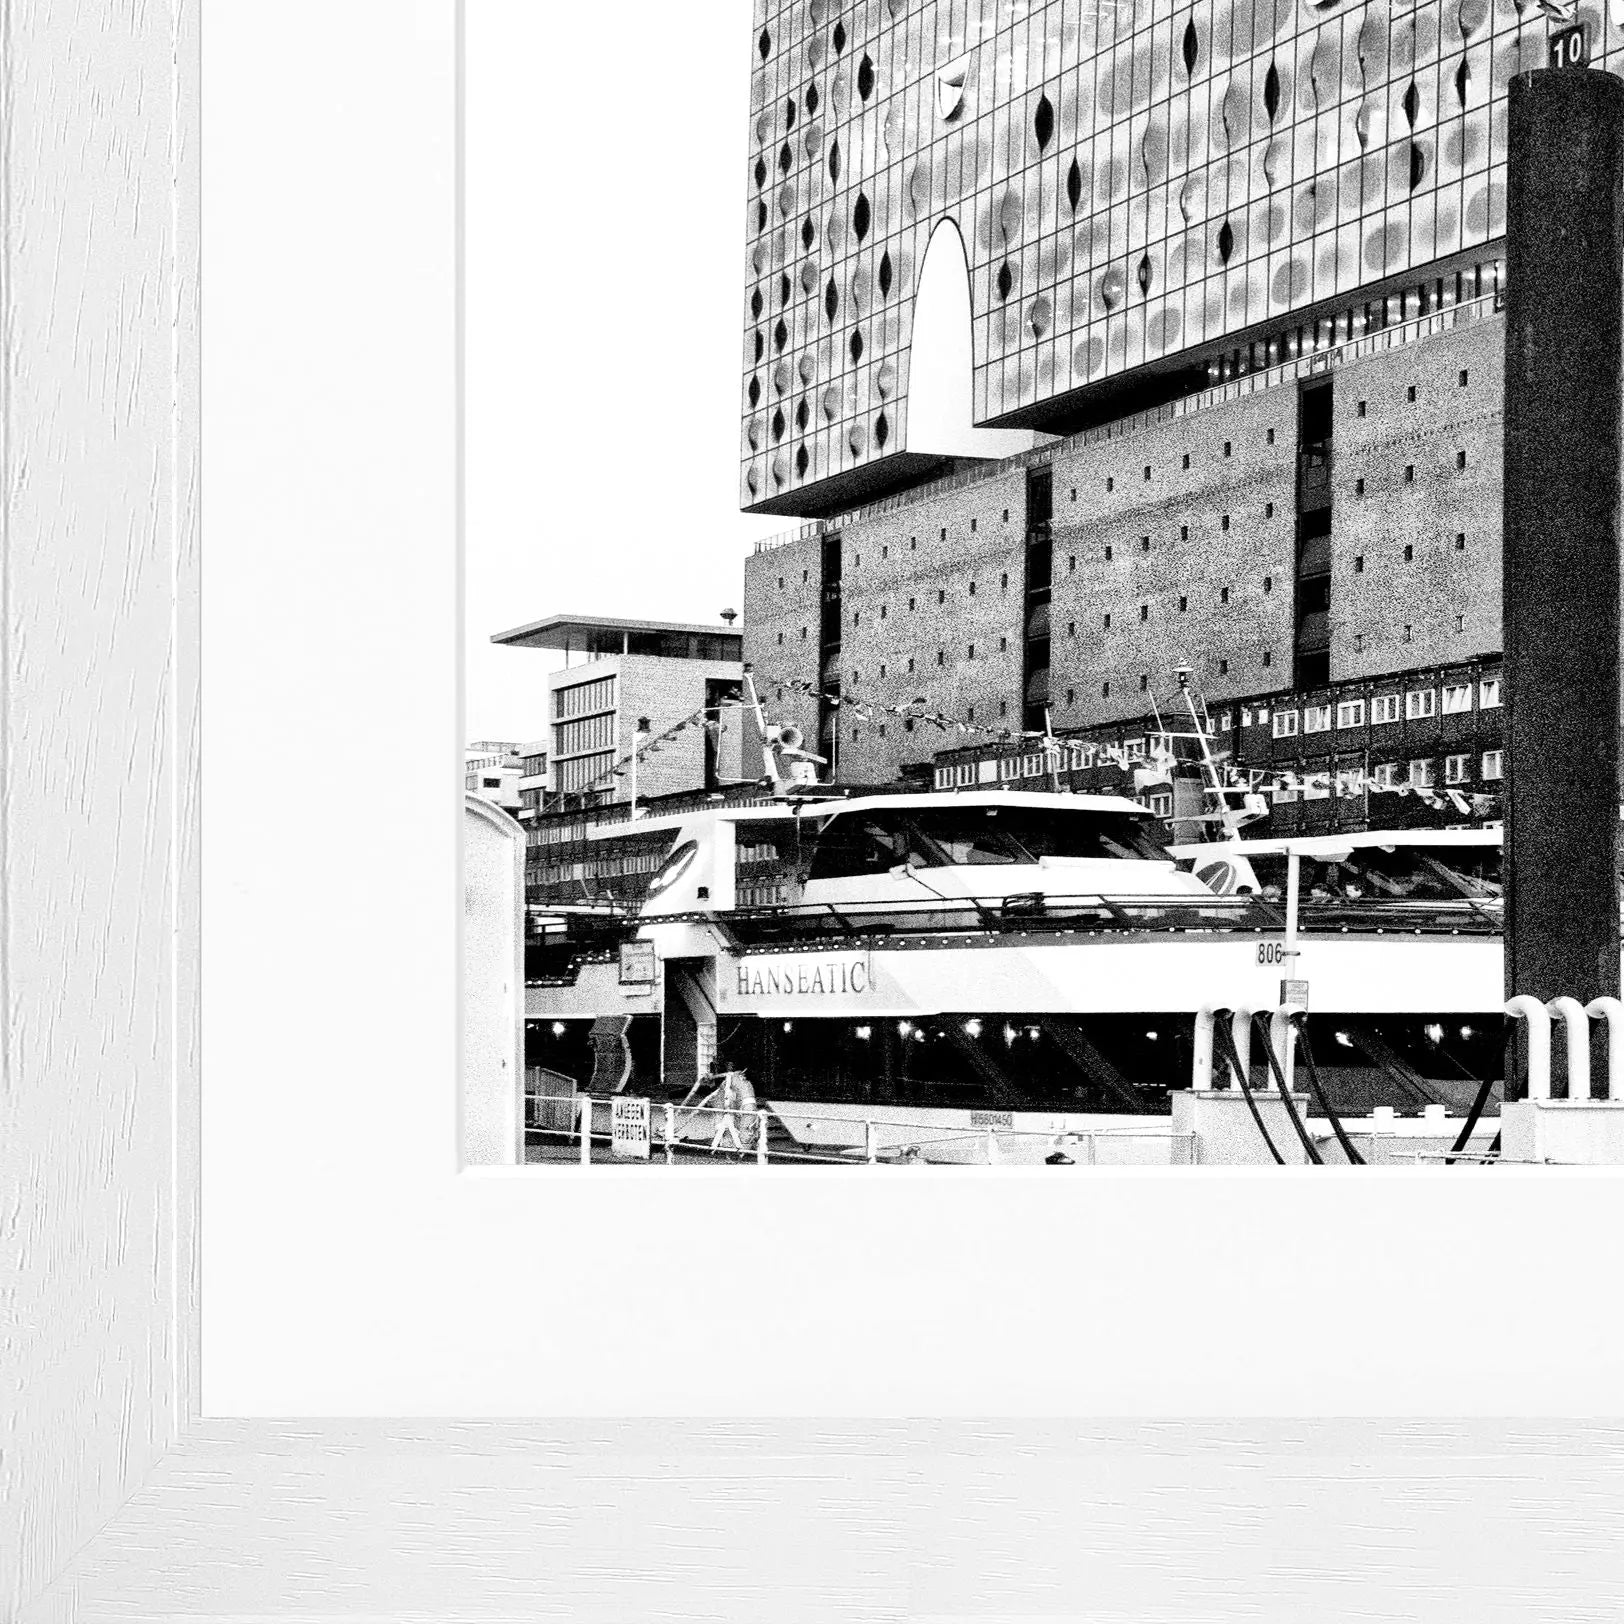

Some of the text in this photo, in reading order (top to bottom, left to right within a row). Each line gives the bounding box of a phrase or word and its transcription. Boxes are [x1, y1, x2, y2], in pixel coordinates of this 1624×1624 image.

[1554, 33, 1582, 68] 10
[1258, 943, 1282, 964] 806
[737, 961, 866, 994] HANSEATIC
